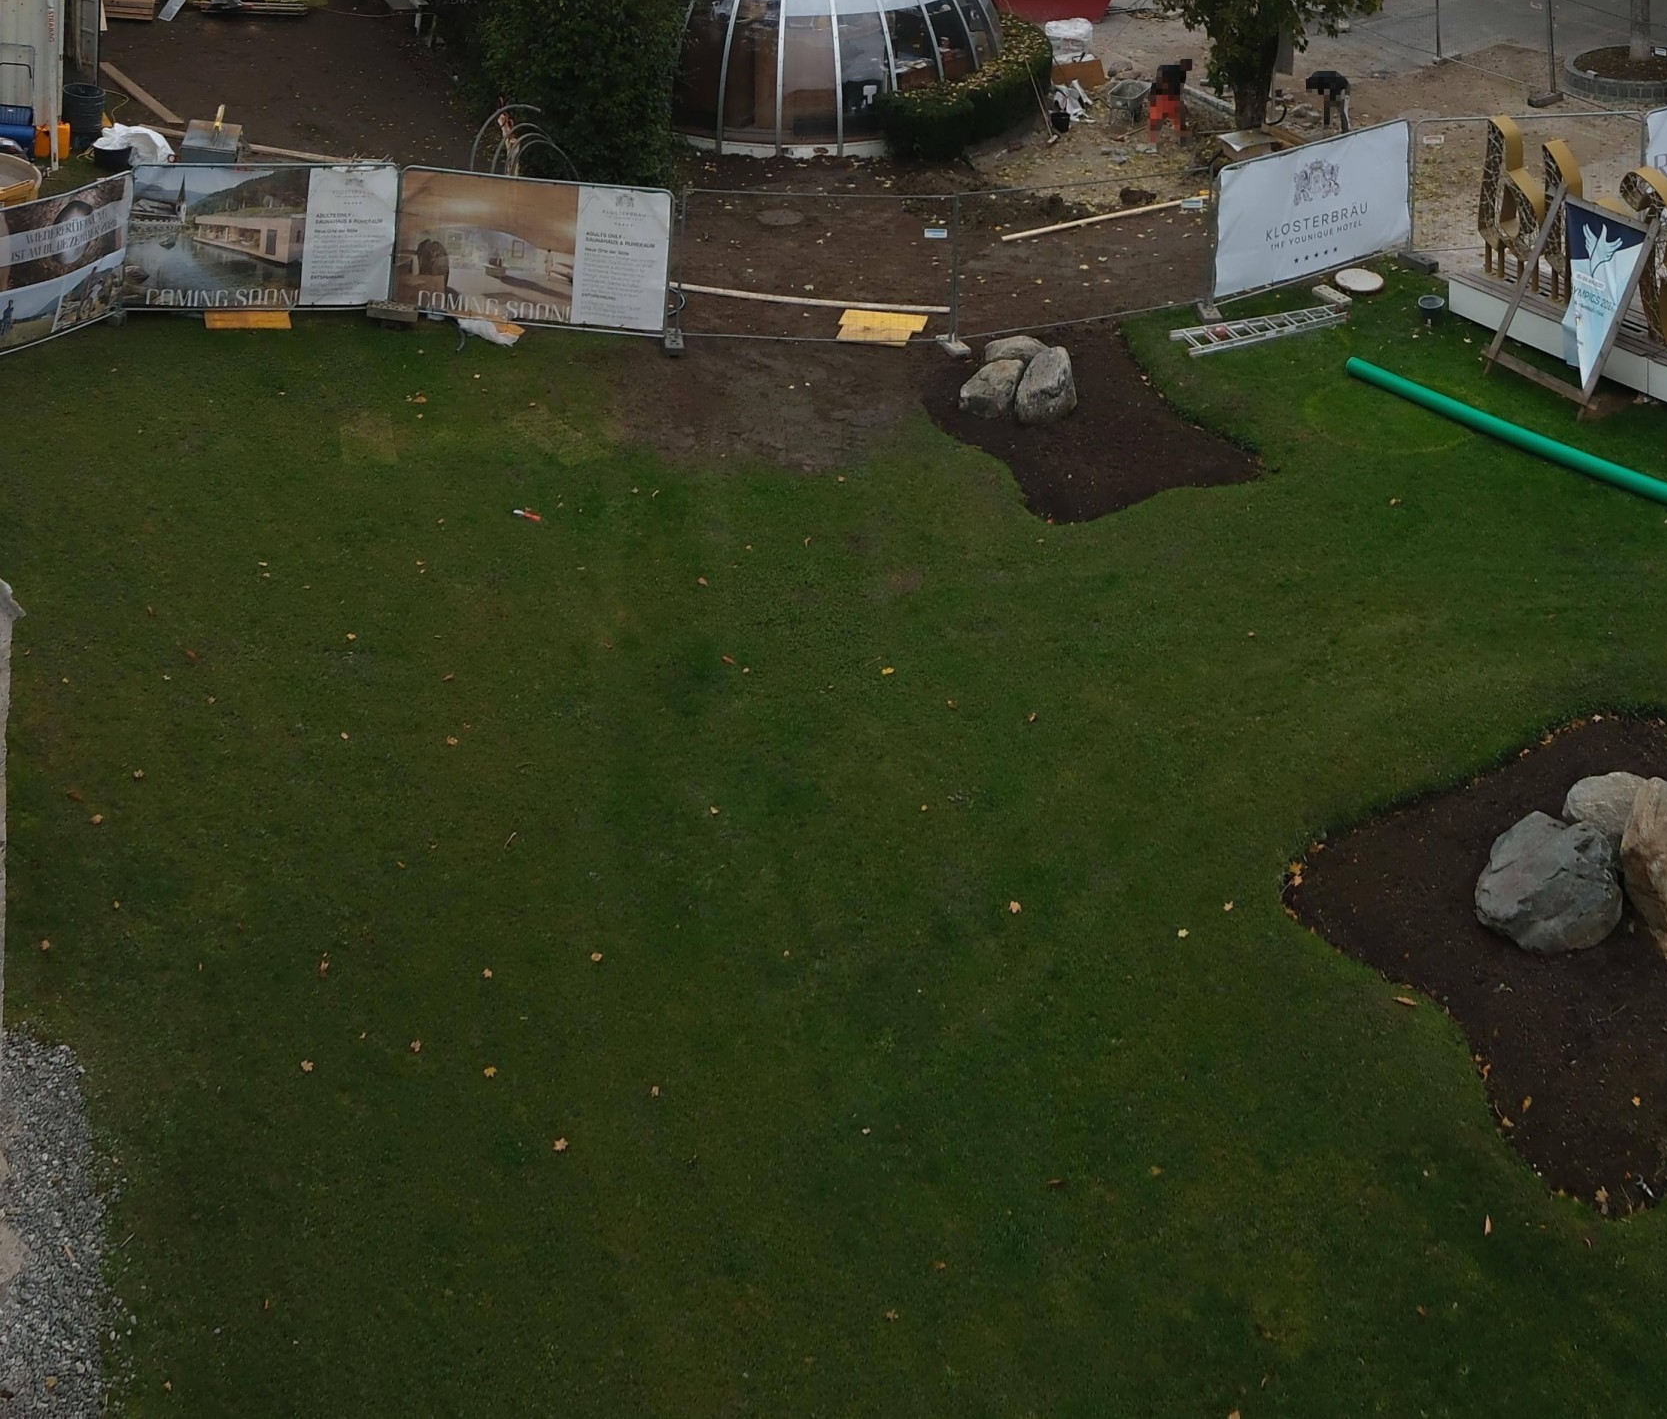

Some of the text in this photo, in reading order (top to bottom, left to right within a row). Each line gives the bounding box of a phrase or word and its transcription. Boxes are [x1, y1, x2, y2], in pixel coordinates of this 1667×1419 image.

[1265, 201, 1368, 242] KLOSTERBRÄU
[1270, 220, 1363, 251] THE YOUNIQUE HOTEL
